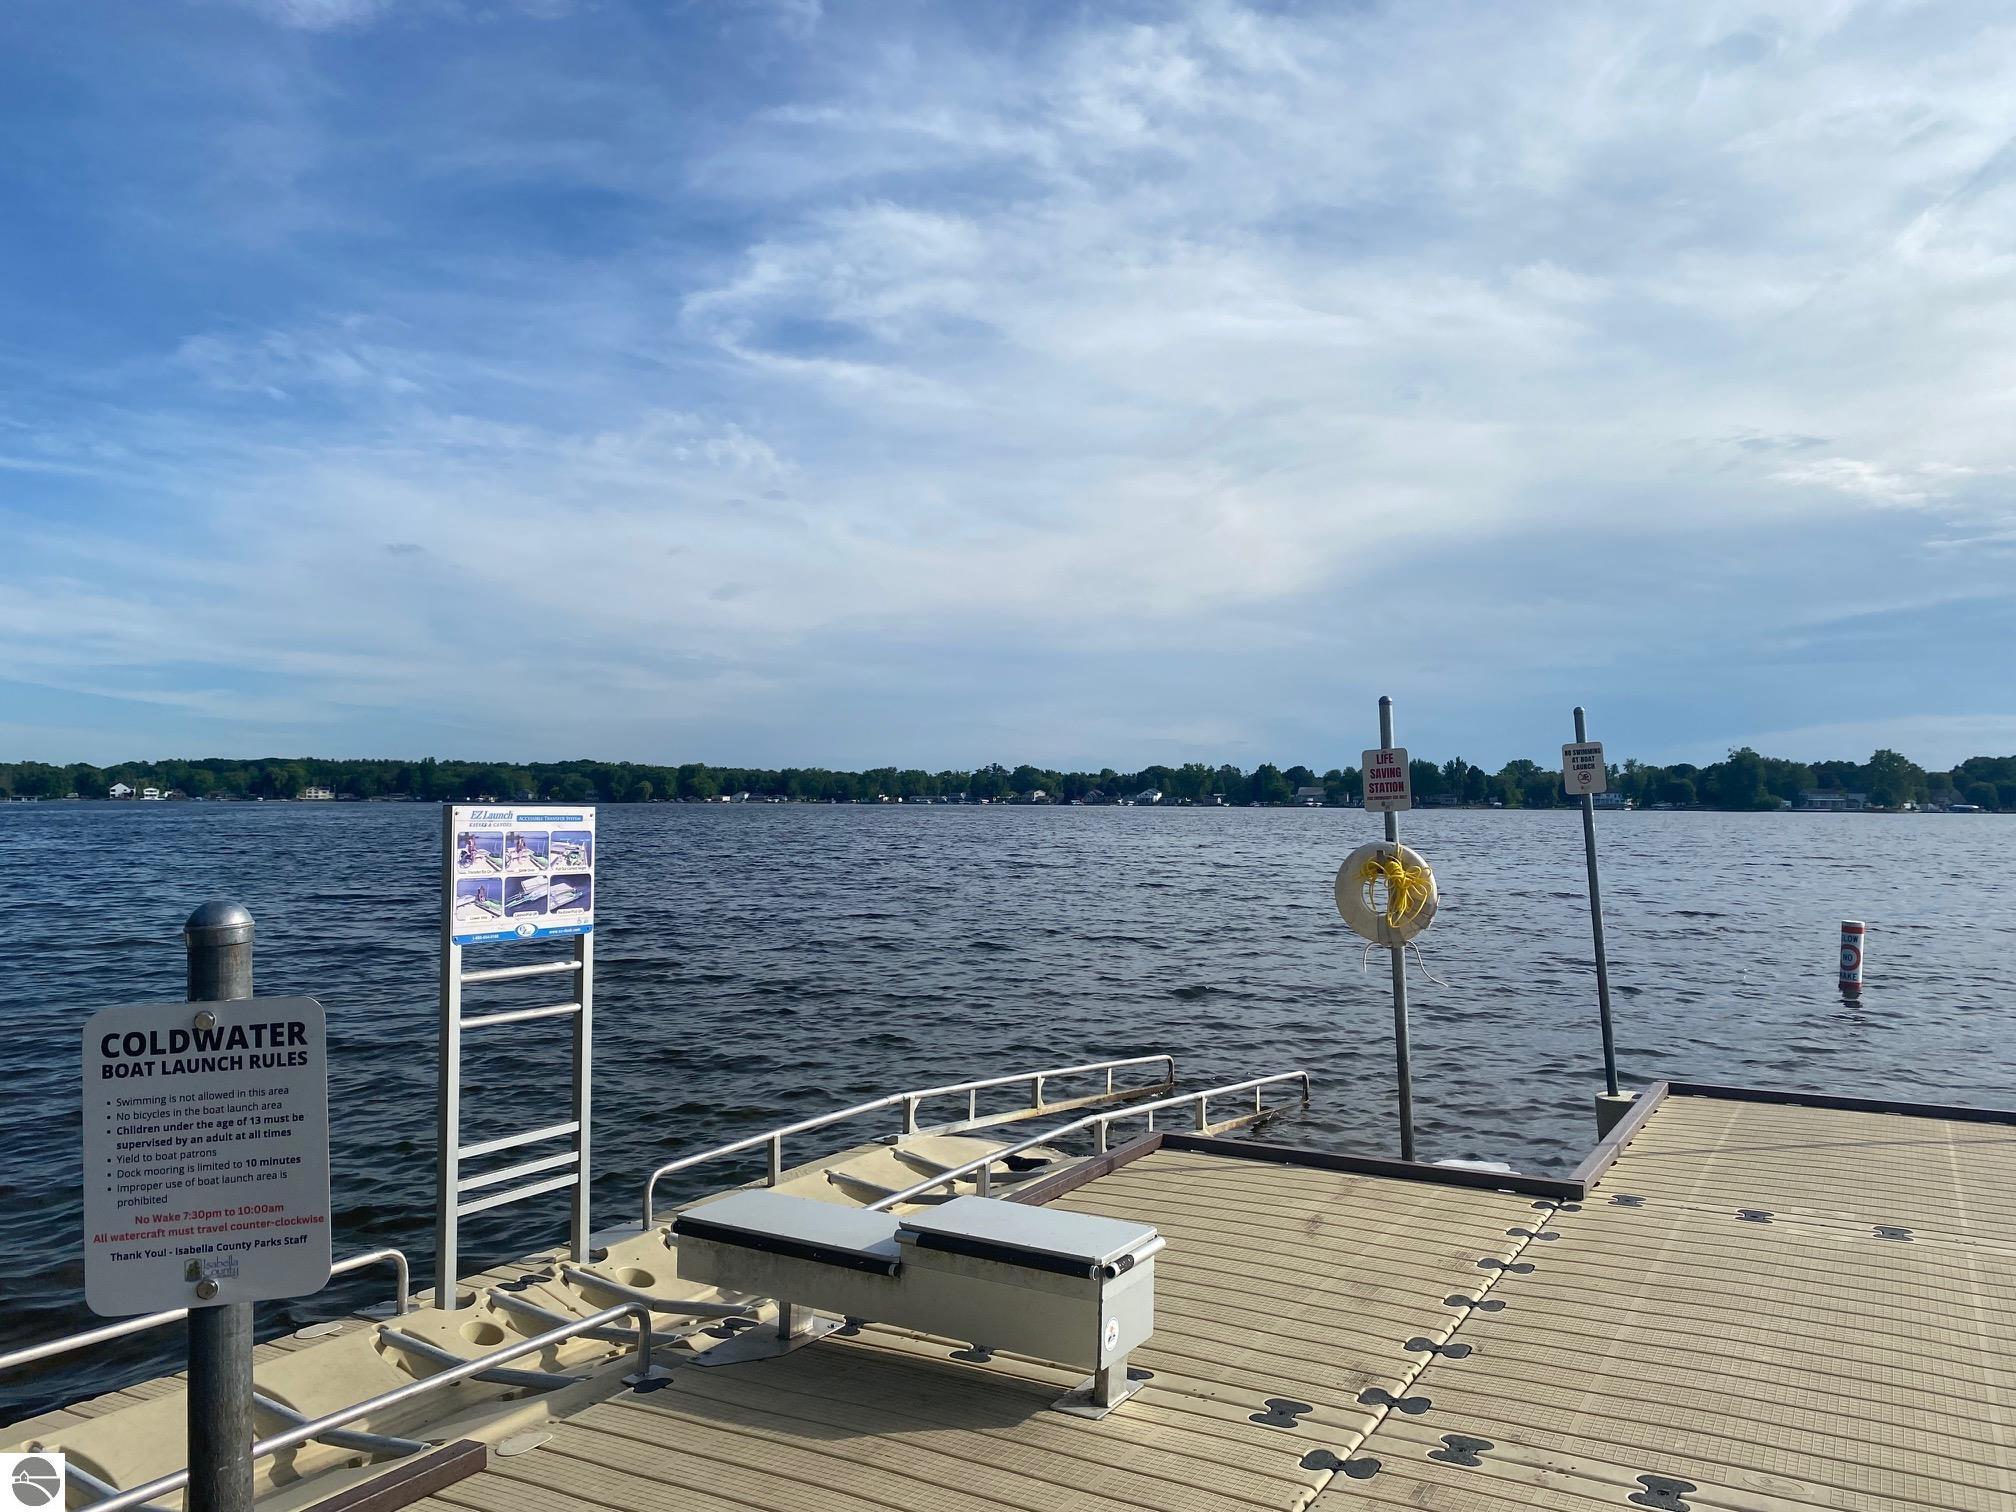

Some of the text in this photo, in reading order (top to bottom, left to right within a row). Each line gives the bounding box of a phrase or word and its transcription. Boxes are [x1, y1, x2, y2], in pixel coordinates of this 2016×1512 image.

[1376, 753, 1394, 764] LIFE
[1370, 766, 1402, 779] SAVING
[1368, 781, 1404, 794] STATION
[483, 810, 514, 820] Launch
[101, 1022, 308, 1058] COLDWATER
[102, 1051, 308, 1080] BOAT LAUNCH RULES
[116, 1087, 289, 1107] Swimming is not allowed in this area
[116, 1102, 282, 1121] No bicycles in the boat launch area
[116, 1113, 304, 1136] Children under the age of 13 must be
[116, 1128, 292, 1150] supervised by an adult at all times
[116, 1150, 217, 1164] Yield to boat patrons
[117, 1155, 302, 1178] Dock mooring is limited to 10 minutes
[117, 1170, 288, 1194] Improper use of boat launch area is
[117, 1194, 168, 1208] prohibited
[135, 1204, 284, 1224] No Wake 7:30pm to 10:00am
[93, 1214, 325, 1244] All watercraft must travel counter-clockwise
[110, 1250, 142, 1262] Thank
[145, 1248, 168, 1259] You!
[175, 1244, 214, 1256] Isabella
[216, 1241, 251, 1253] County
[254, 1238, 282, 1249] Parks
[284, 1234, 308, 1246] Staff
[204, 1254, 239, 1269] Isabella
